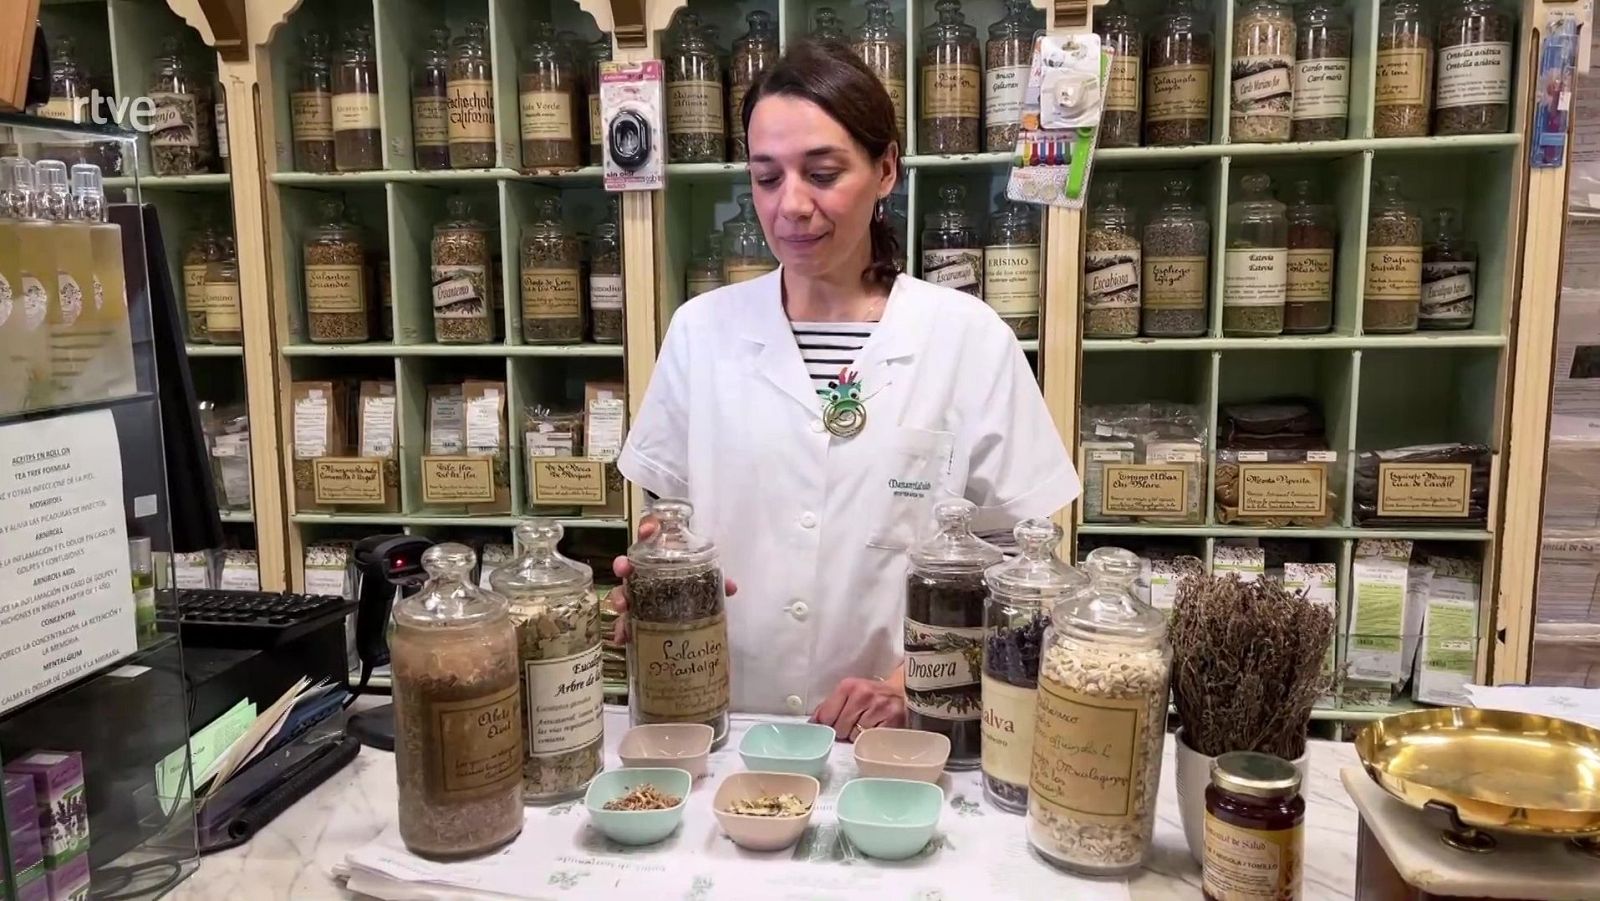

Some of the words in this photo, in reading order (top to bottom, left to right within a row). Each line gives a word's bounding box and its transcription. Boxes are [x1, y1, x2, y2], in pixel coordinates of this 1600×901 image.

[908, 656, 956, 678] Drosera
[554, 678, 584, 698] Arbre
[586, 675, 594, 688] de
[983, 708, 1016, 734] alva
